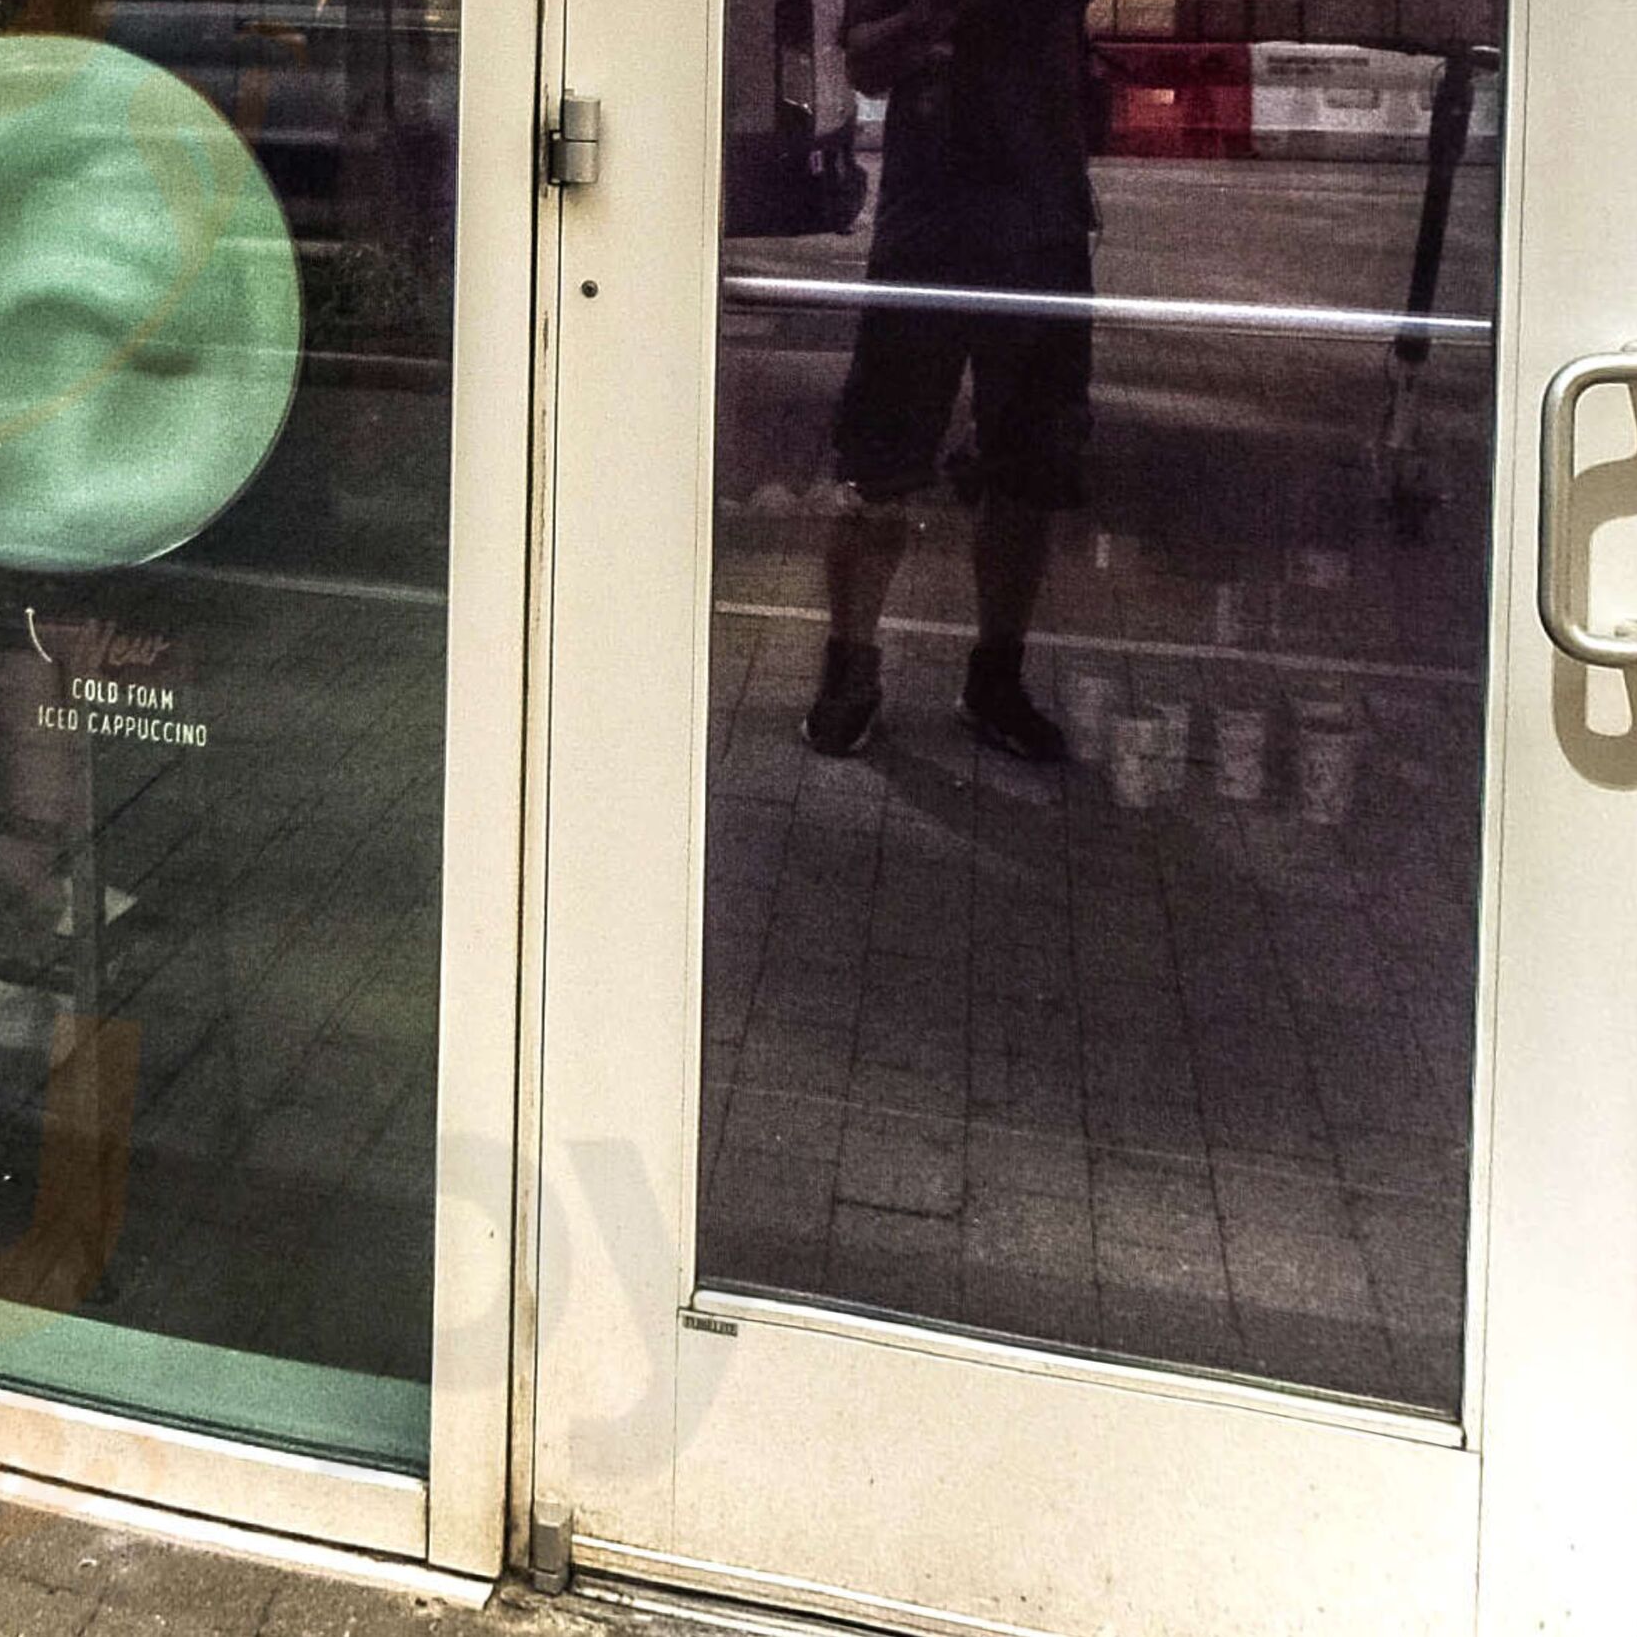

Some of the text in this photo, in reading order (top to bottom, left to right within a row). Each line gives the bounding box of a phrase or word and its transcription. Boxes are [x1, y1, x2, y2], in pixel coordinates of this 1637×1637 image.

[76, 617, 172, 667] New
[72, 677, 175, 711] COLD FOAM
[38, 705, 208, 747] ICED CAPPUCCINO
